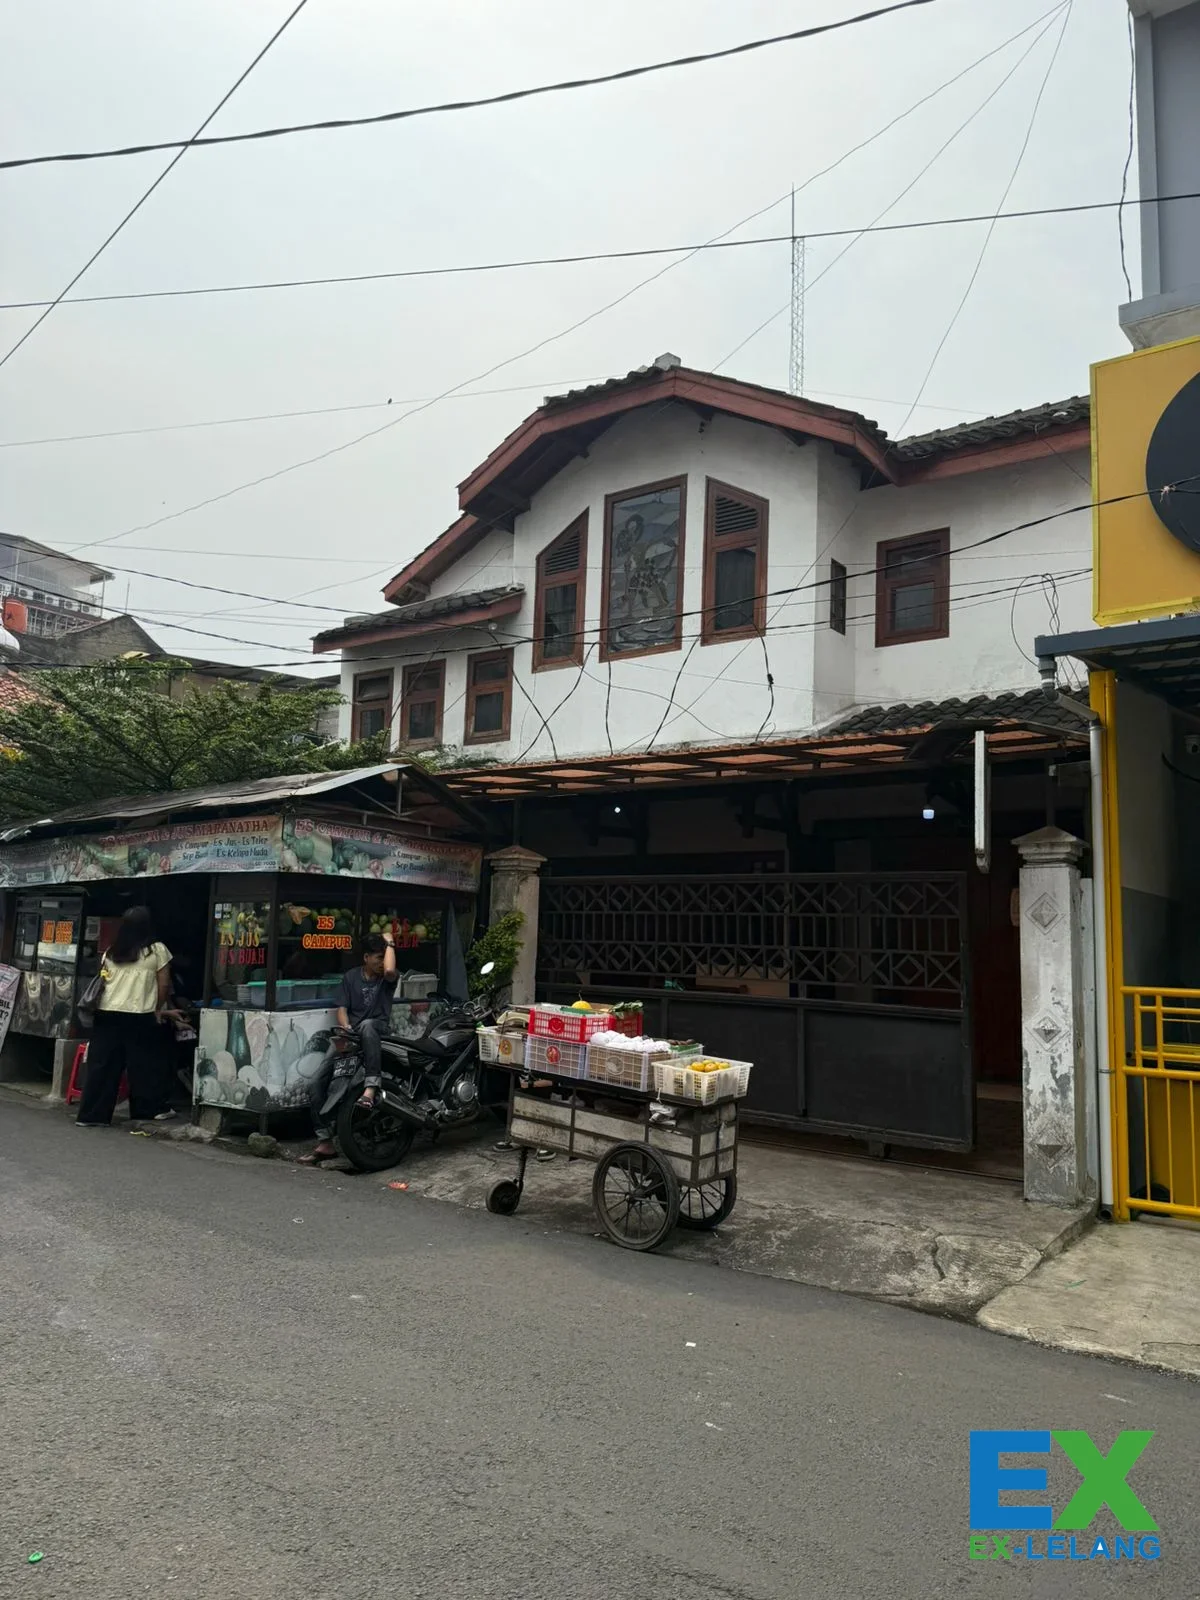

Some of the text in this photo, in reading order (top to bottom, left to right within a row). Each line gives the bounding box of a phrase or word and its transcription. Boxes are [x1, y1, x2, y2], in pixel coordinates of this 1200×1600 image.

[295, 819, 314, 833] ES
[317, 823, 371, 842] CAMPUR
[317, 915, 335, 930] ES
[218, 931, 260, 947] ES JUS
[302, 933, 352, 949] CAMPUR
[238, 948, 265, 965] BUAH
